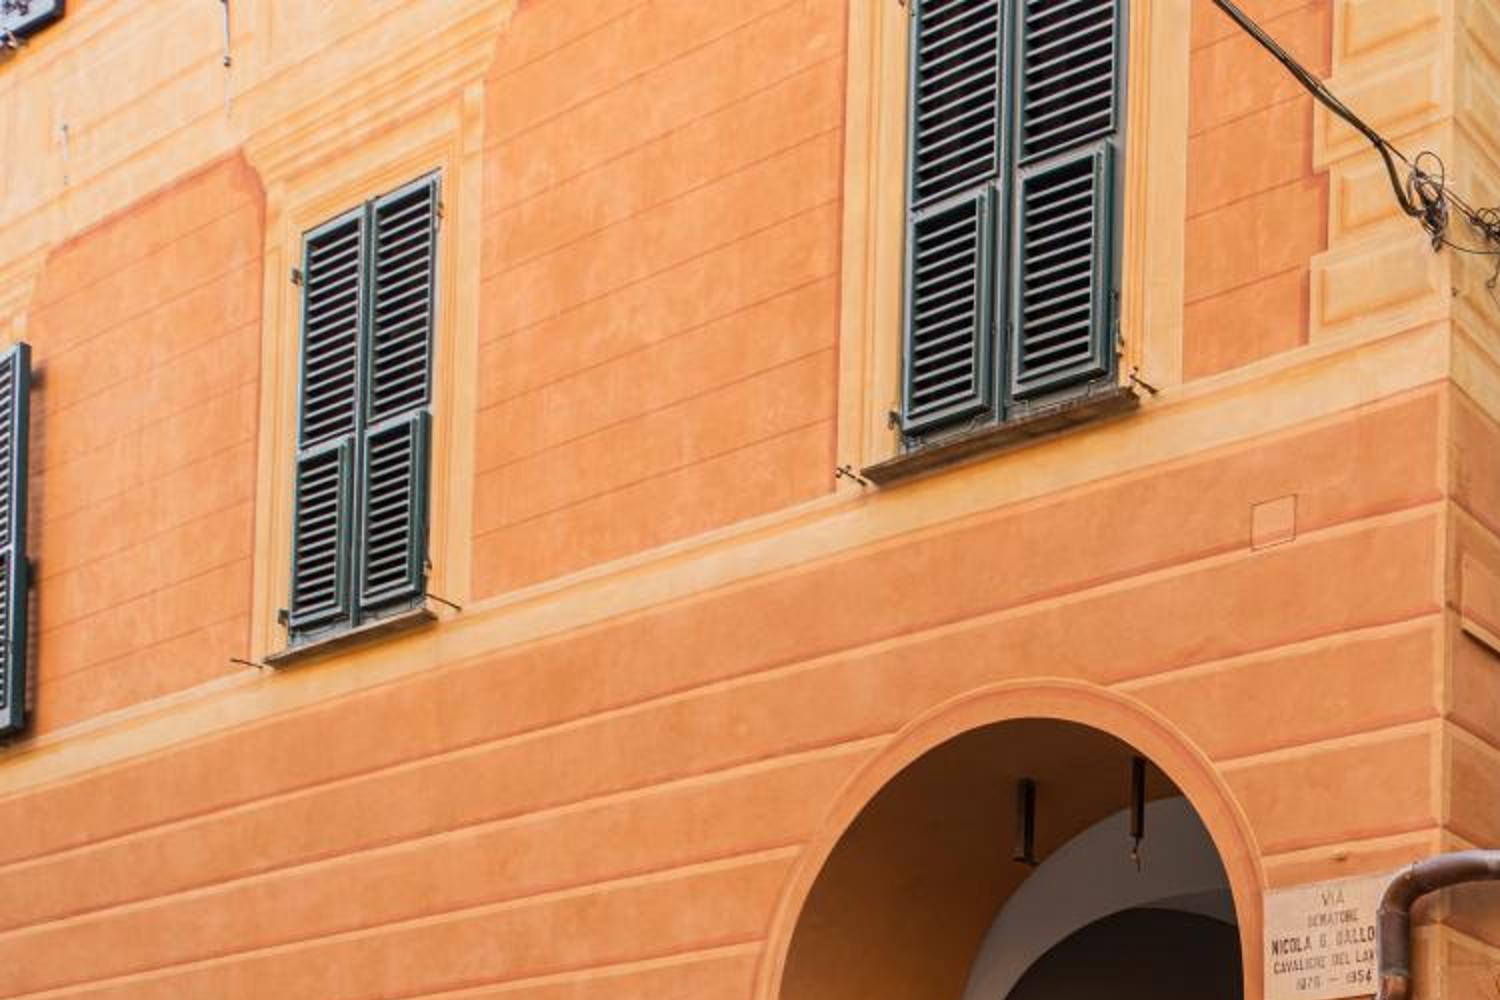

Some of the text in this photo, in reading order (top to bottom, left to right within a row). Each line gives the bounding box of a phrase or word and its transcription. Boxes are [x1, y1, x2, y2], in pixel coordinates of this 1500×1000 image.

[1321, 890, 1345, 906] VIA
[1271, 936, 1312, 956] NICOLA
[1332, 951, 1350, 966] DEL
